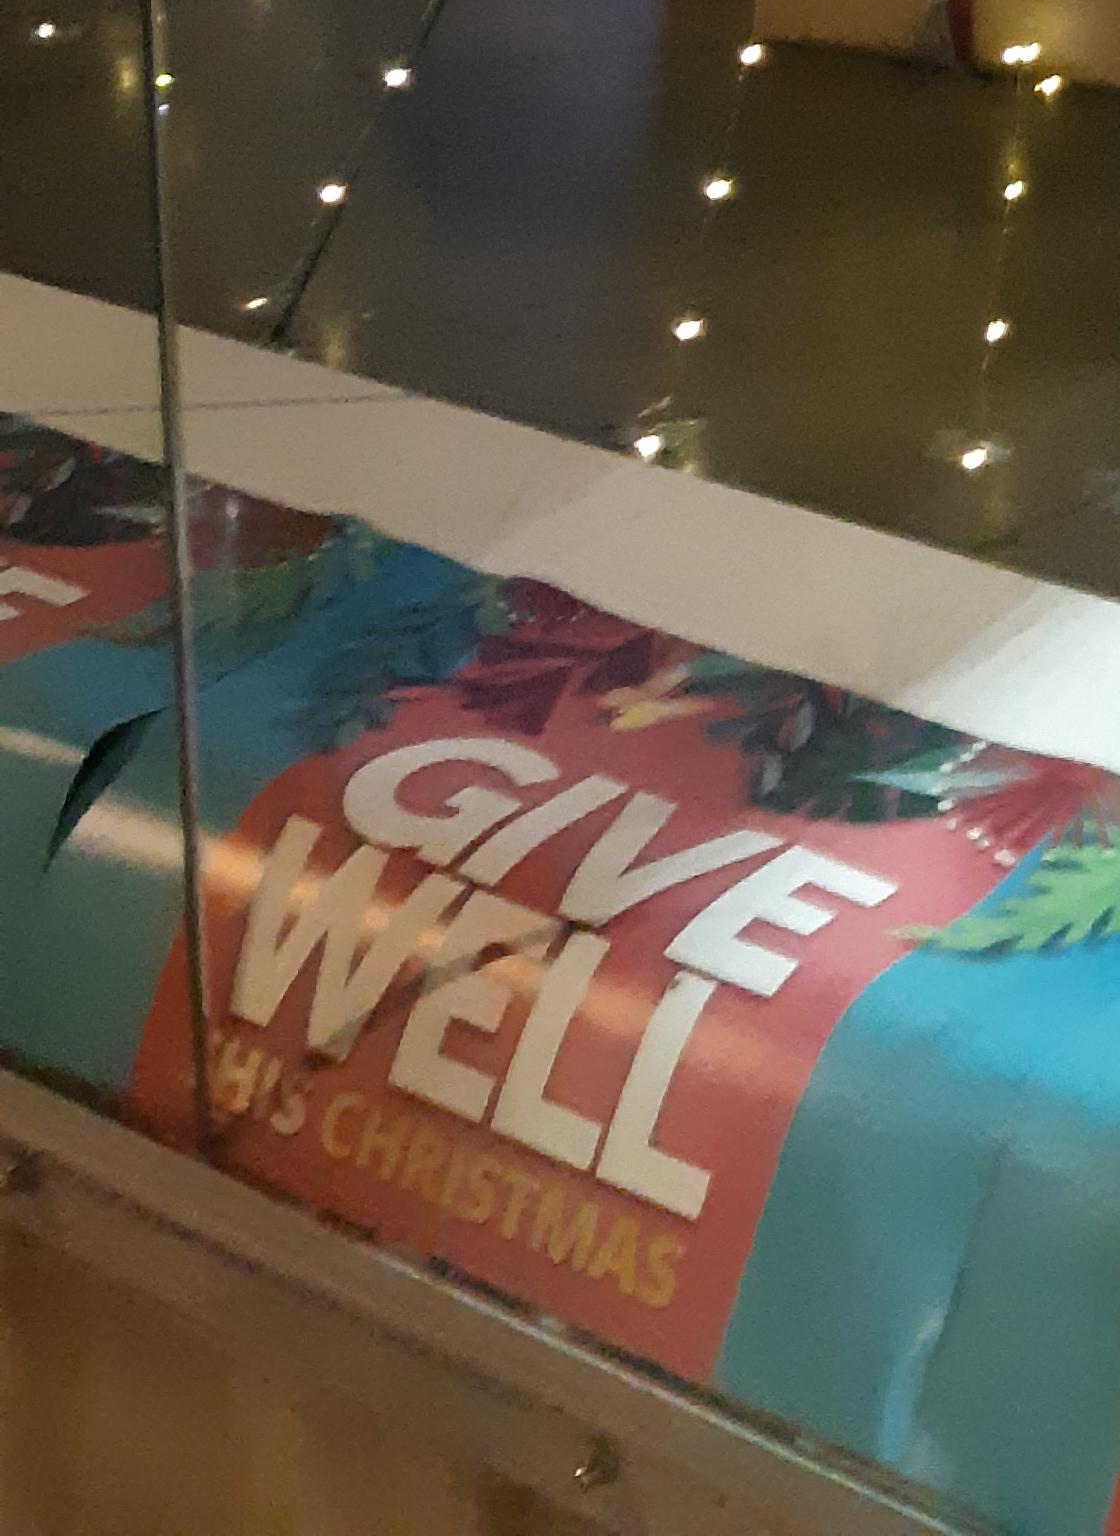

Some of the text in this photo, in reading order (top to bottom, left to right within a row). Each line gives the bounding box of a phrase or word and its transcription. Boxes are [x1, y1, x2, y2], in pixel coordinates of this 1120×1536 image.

[345, 737, 898, 998] GIVE
[229, 815, 712, 1221] WELL
[208, 1030, 686, 1310] HIS CHRISTMAS
